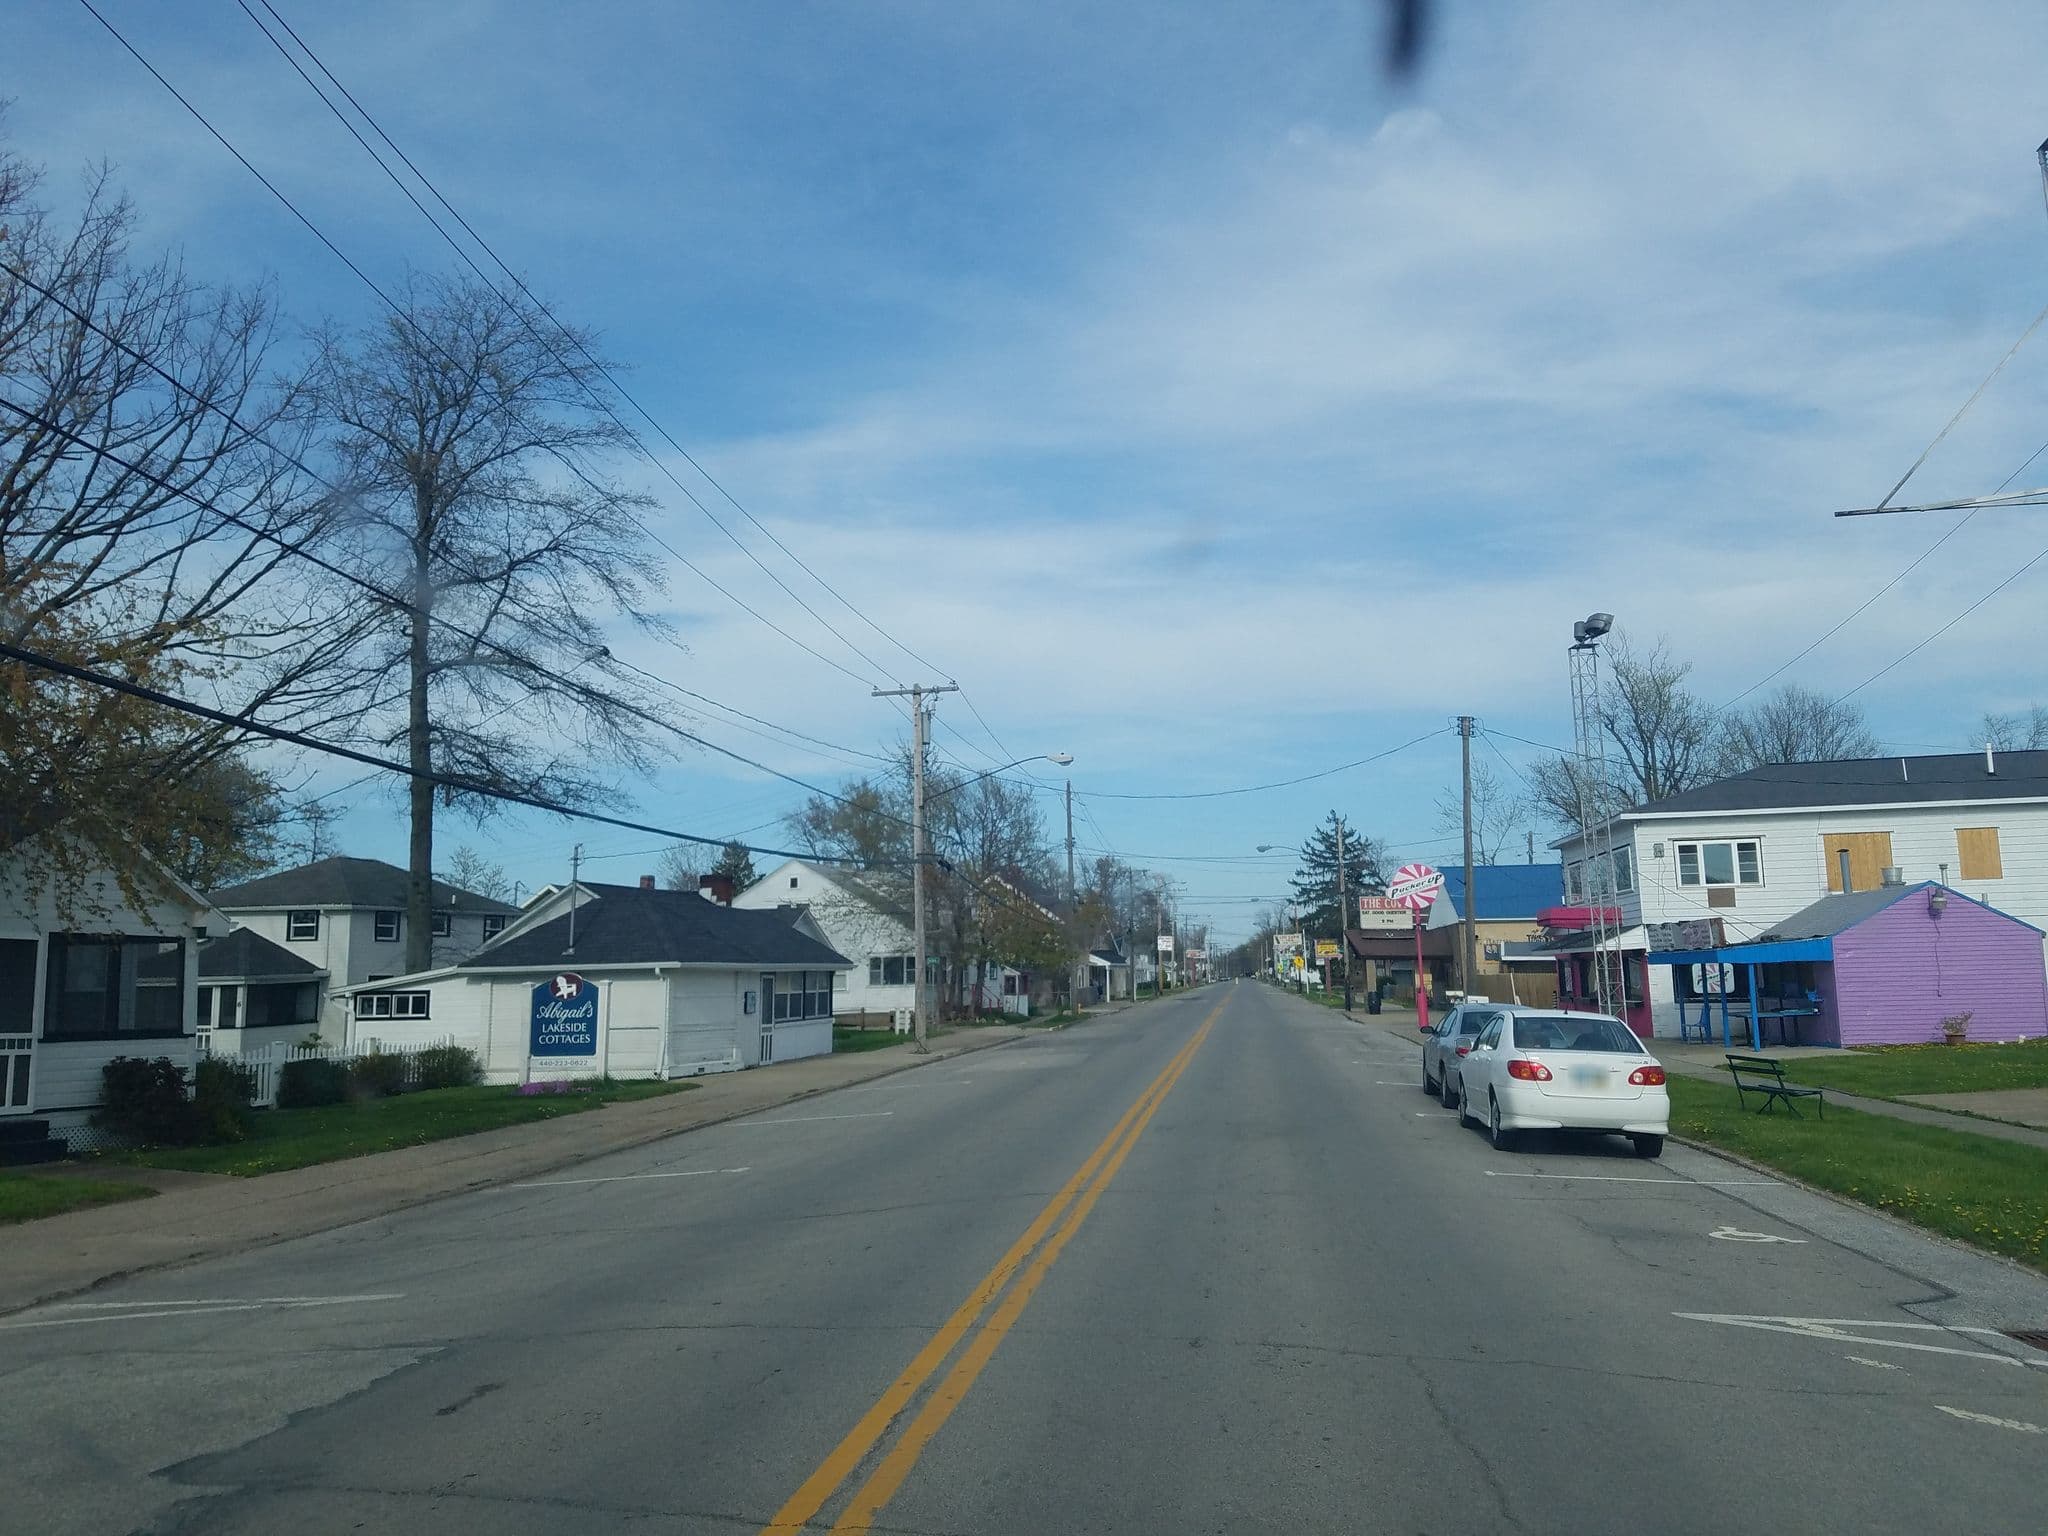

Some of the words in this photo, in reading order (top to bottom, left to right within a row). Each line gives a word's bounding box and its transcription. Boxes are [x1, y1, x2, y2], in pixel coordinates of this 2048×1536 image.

[1361, 898, 1381, 909] THE
[1384, 898, 1402, 909] COV
[536, 1000, 594, 1024] Abigail's
[542, 1022, 587, 1033] LAKESIDE
[538, 1034, 591, 1045] COTTAGES
